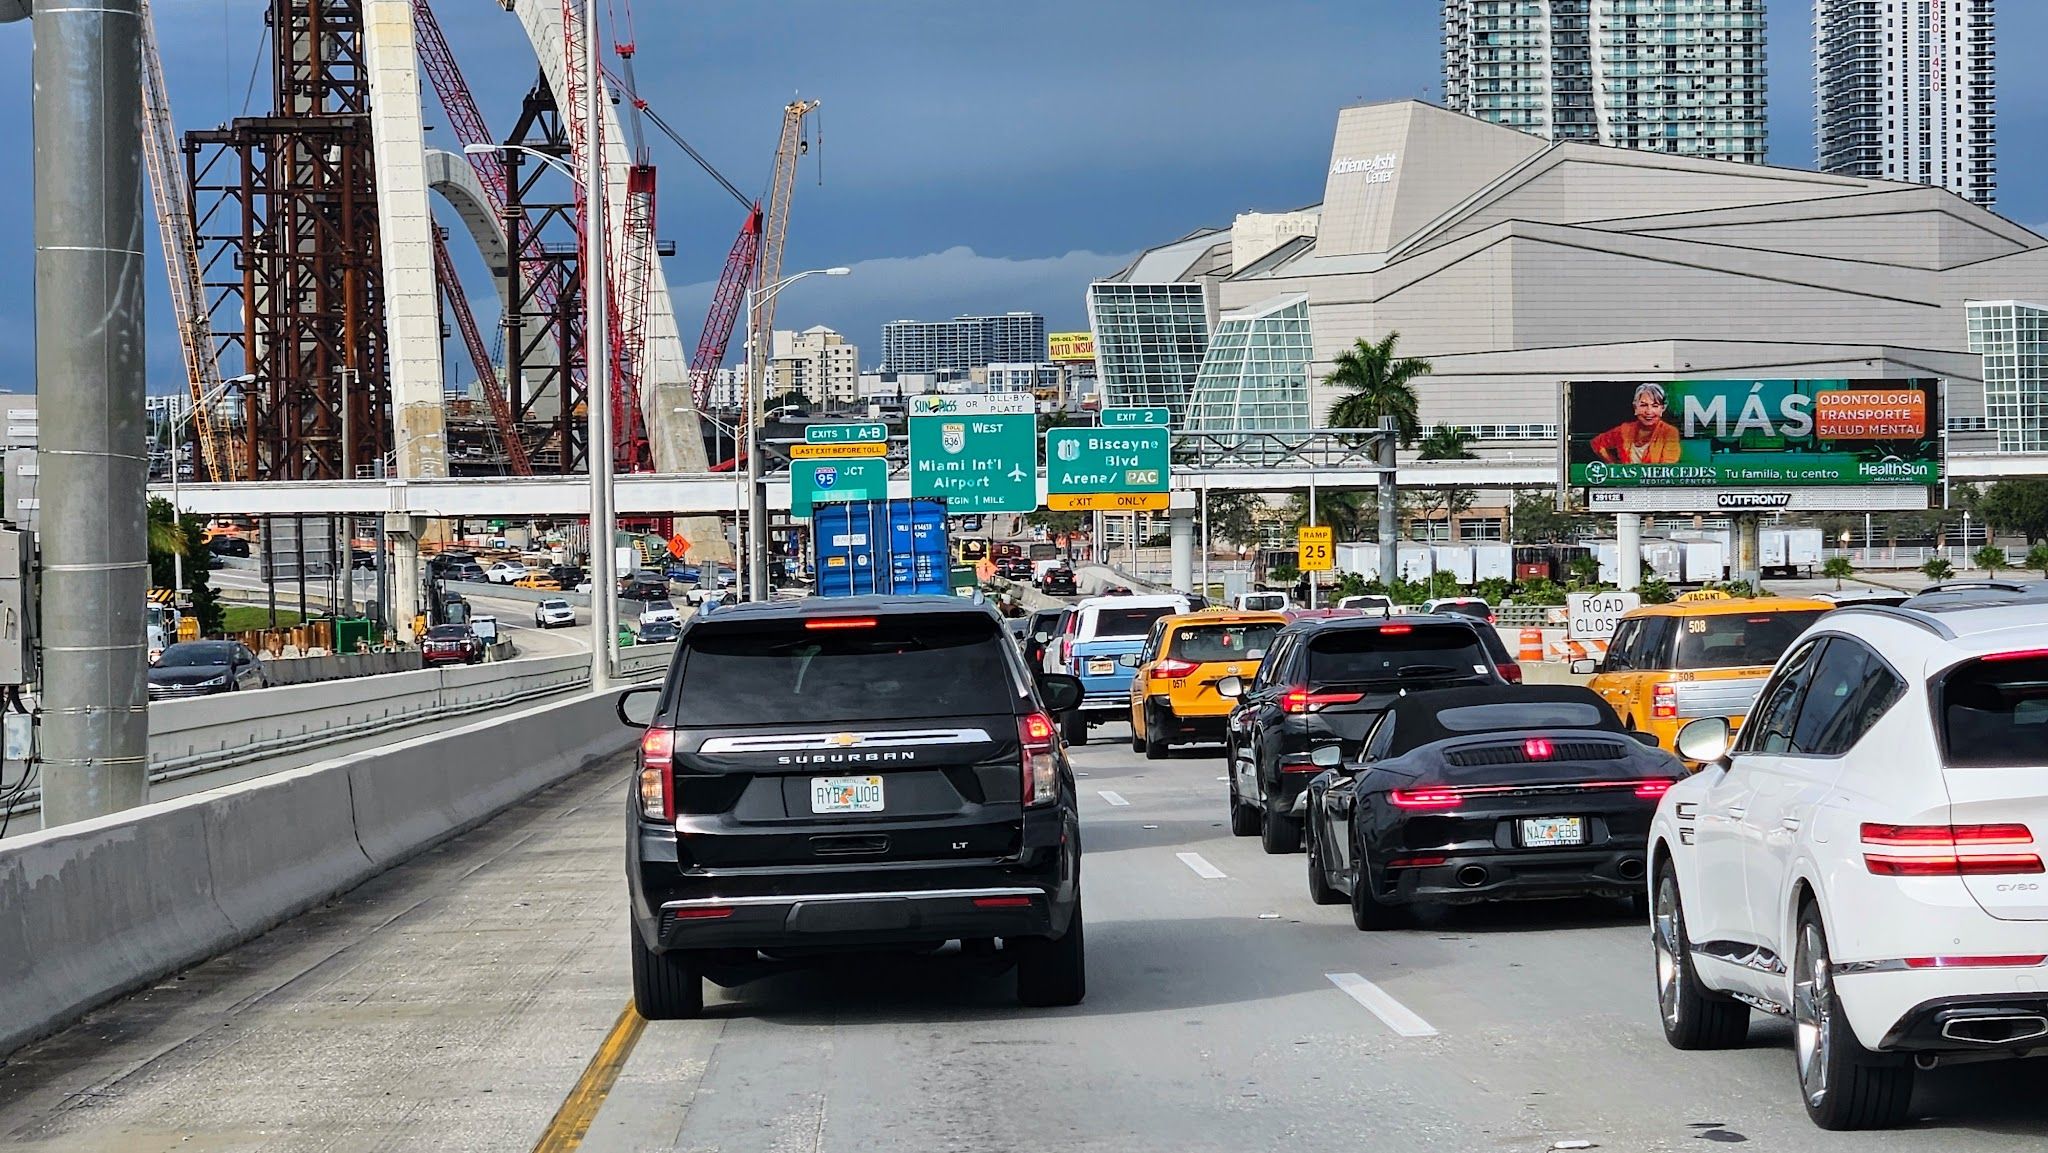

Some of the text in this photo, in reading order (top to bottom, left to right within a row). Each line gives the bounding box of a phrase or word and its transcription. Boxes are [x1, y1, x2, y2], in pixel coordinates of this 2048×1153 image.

[1329, 153, 1396, 175] Adrienne Arsht
[1366, 170, 1394, 184] Center
[1050, 344, 1070, 356] AUTO
[1819, 391, 1922, 406] ODONTOLOGÍA
[990, 405, 1023, 413] PLATE
[1683, 382, 1814, 438] MÁS
[1819, 409, 1911, 421] TRANSPORTE
[1116, 411, 1153, 422] EXIT 2
[811, 427, 881, 439] EXITS 1 A-B
[1820, 424, 1924, 436] SALUD MENTAL
[944, 437, 959, 446] 836
[1088, 438, 1159, 452] Biscayne
[919, 459, 965, 472] Miami
[1105, 455, 1139, 467] Blvd
[843, 467, 864, 476] JCT
[1610, 467, 1717, 478] LAS MERCEDES
[1725, 468, 1839, 480] Tu familia, tu centro
[1859, 463, 1928, 475] HealthSun
[818, 474, 834, 485] 95
[933, 476, 990, 490] Airport
[1127, 472, 1157, 483] PAC
[947, 495, 1005, 505] EGIN 1 MILE
[1117, 497, 1147, 506] ONLY
[1305, 545, 1326, 558] 25
[1688, 592, 1721, 602] VACANT
[1582, 598, 1624, 613] ROAD
[1689, 620, 1706, 634] 508
[1678, 672, 1695, 682] 508
[1172, 680, 1187, 688] 0571
[778, 751, 915, 765] SUBURBAN
[1526, 826, 1546, 839] NAZ
[952, 841, 969, 850] LT
[1996, 883, 2039, 892] GV80
